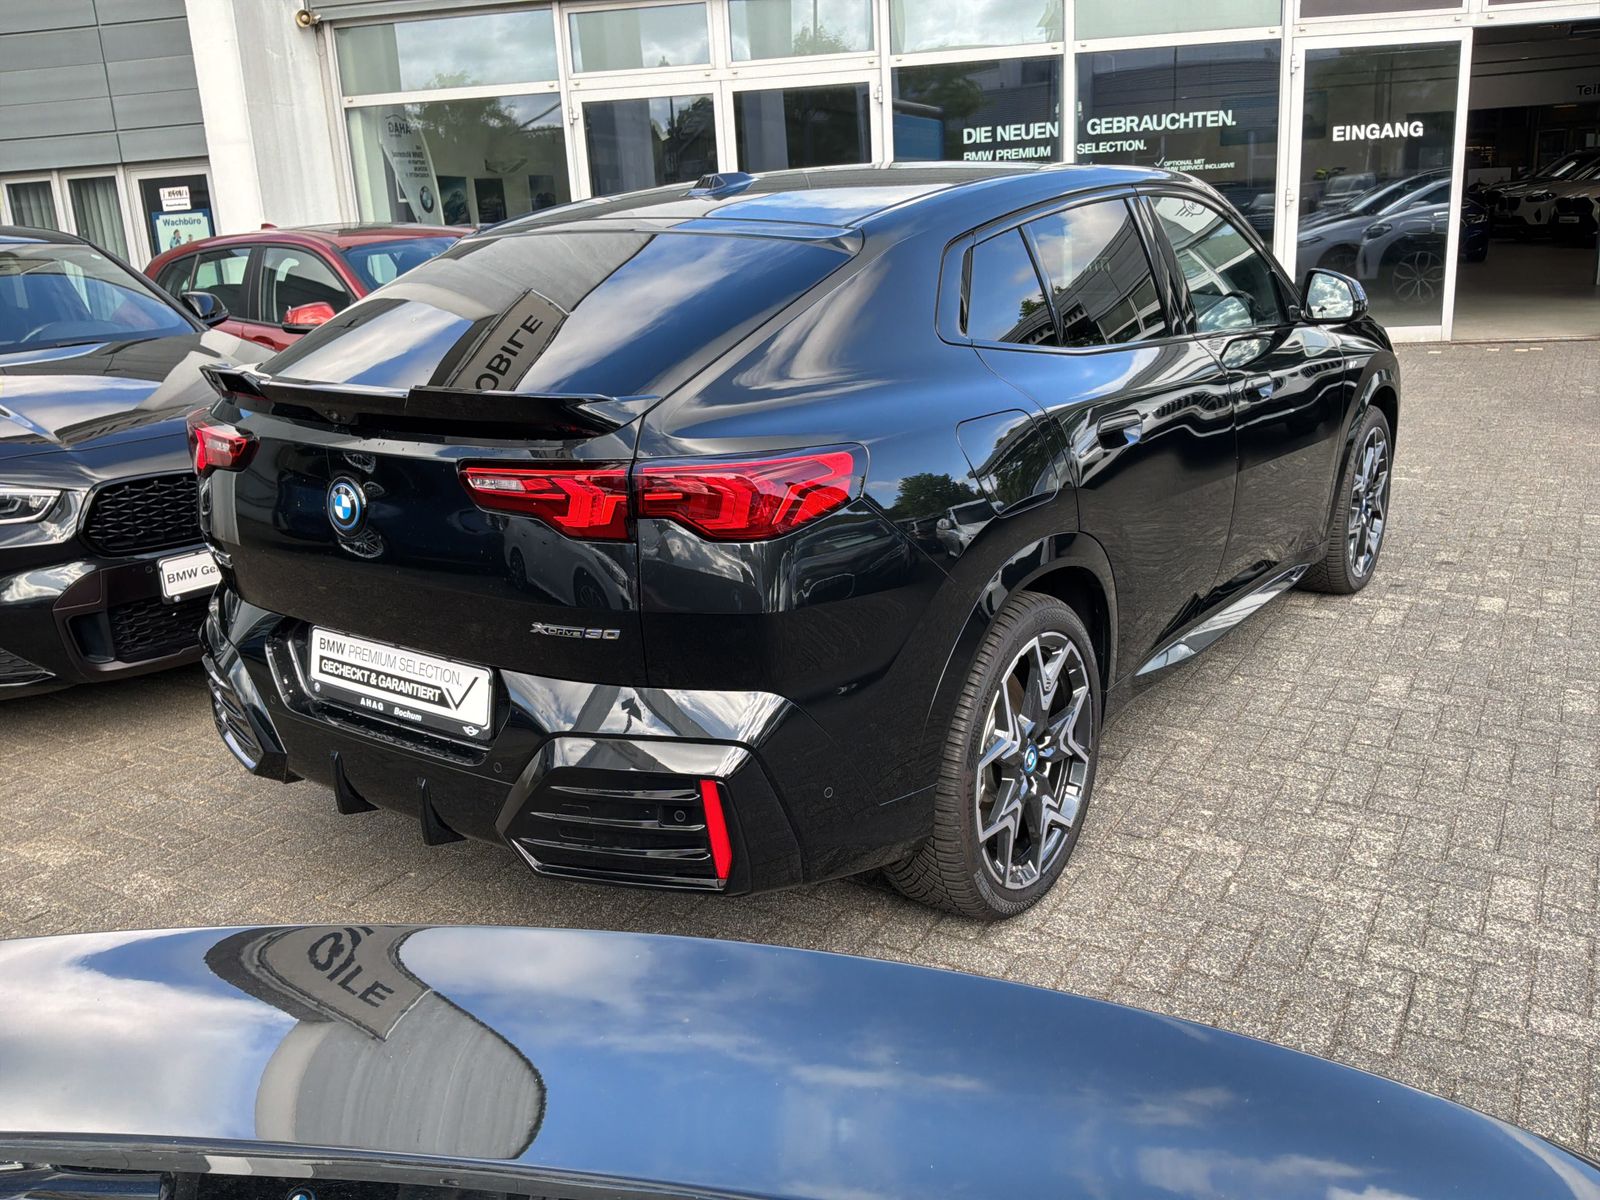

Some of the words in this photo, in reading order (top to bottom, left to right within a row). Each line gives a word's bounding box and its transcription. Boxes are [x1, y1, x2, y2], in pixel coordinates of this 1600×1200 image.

[963, 126, 992, 145] DIE
[996, 121, 1059, 142] NEUEN
[1086, 110, 1237, 135] GEBRAUCHTEN.
[1332, 121, 1424, 142] EINGANG
[963, 149, 993, 161] BMW
[995, 146, 1051, 161] PREMIUM
[1076, 139, 1147, 155] SELECTION.
[163, 217, 202, 227] Wachbüro
[167, 567, 198, 584] BMW
[320, 637, 346, 655] BMW
[348, 644, 397, 669] PREMIUM
[399, 657, 462, 687] SELECTION.
[321, 659, 370, 683] GECHECKT
[370, 672, 377, 685] &
[378, 674, 441, 702] GARANTIERT
[360, 697, 384, 711] AHAG
[394, 706, 422, 721] Bochum
